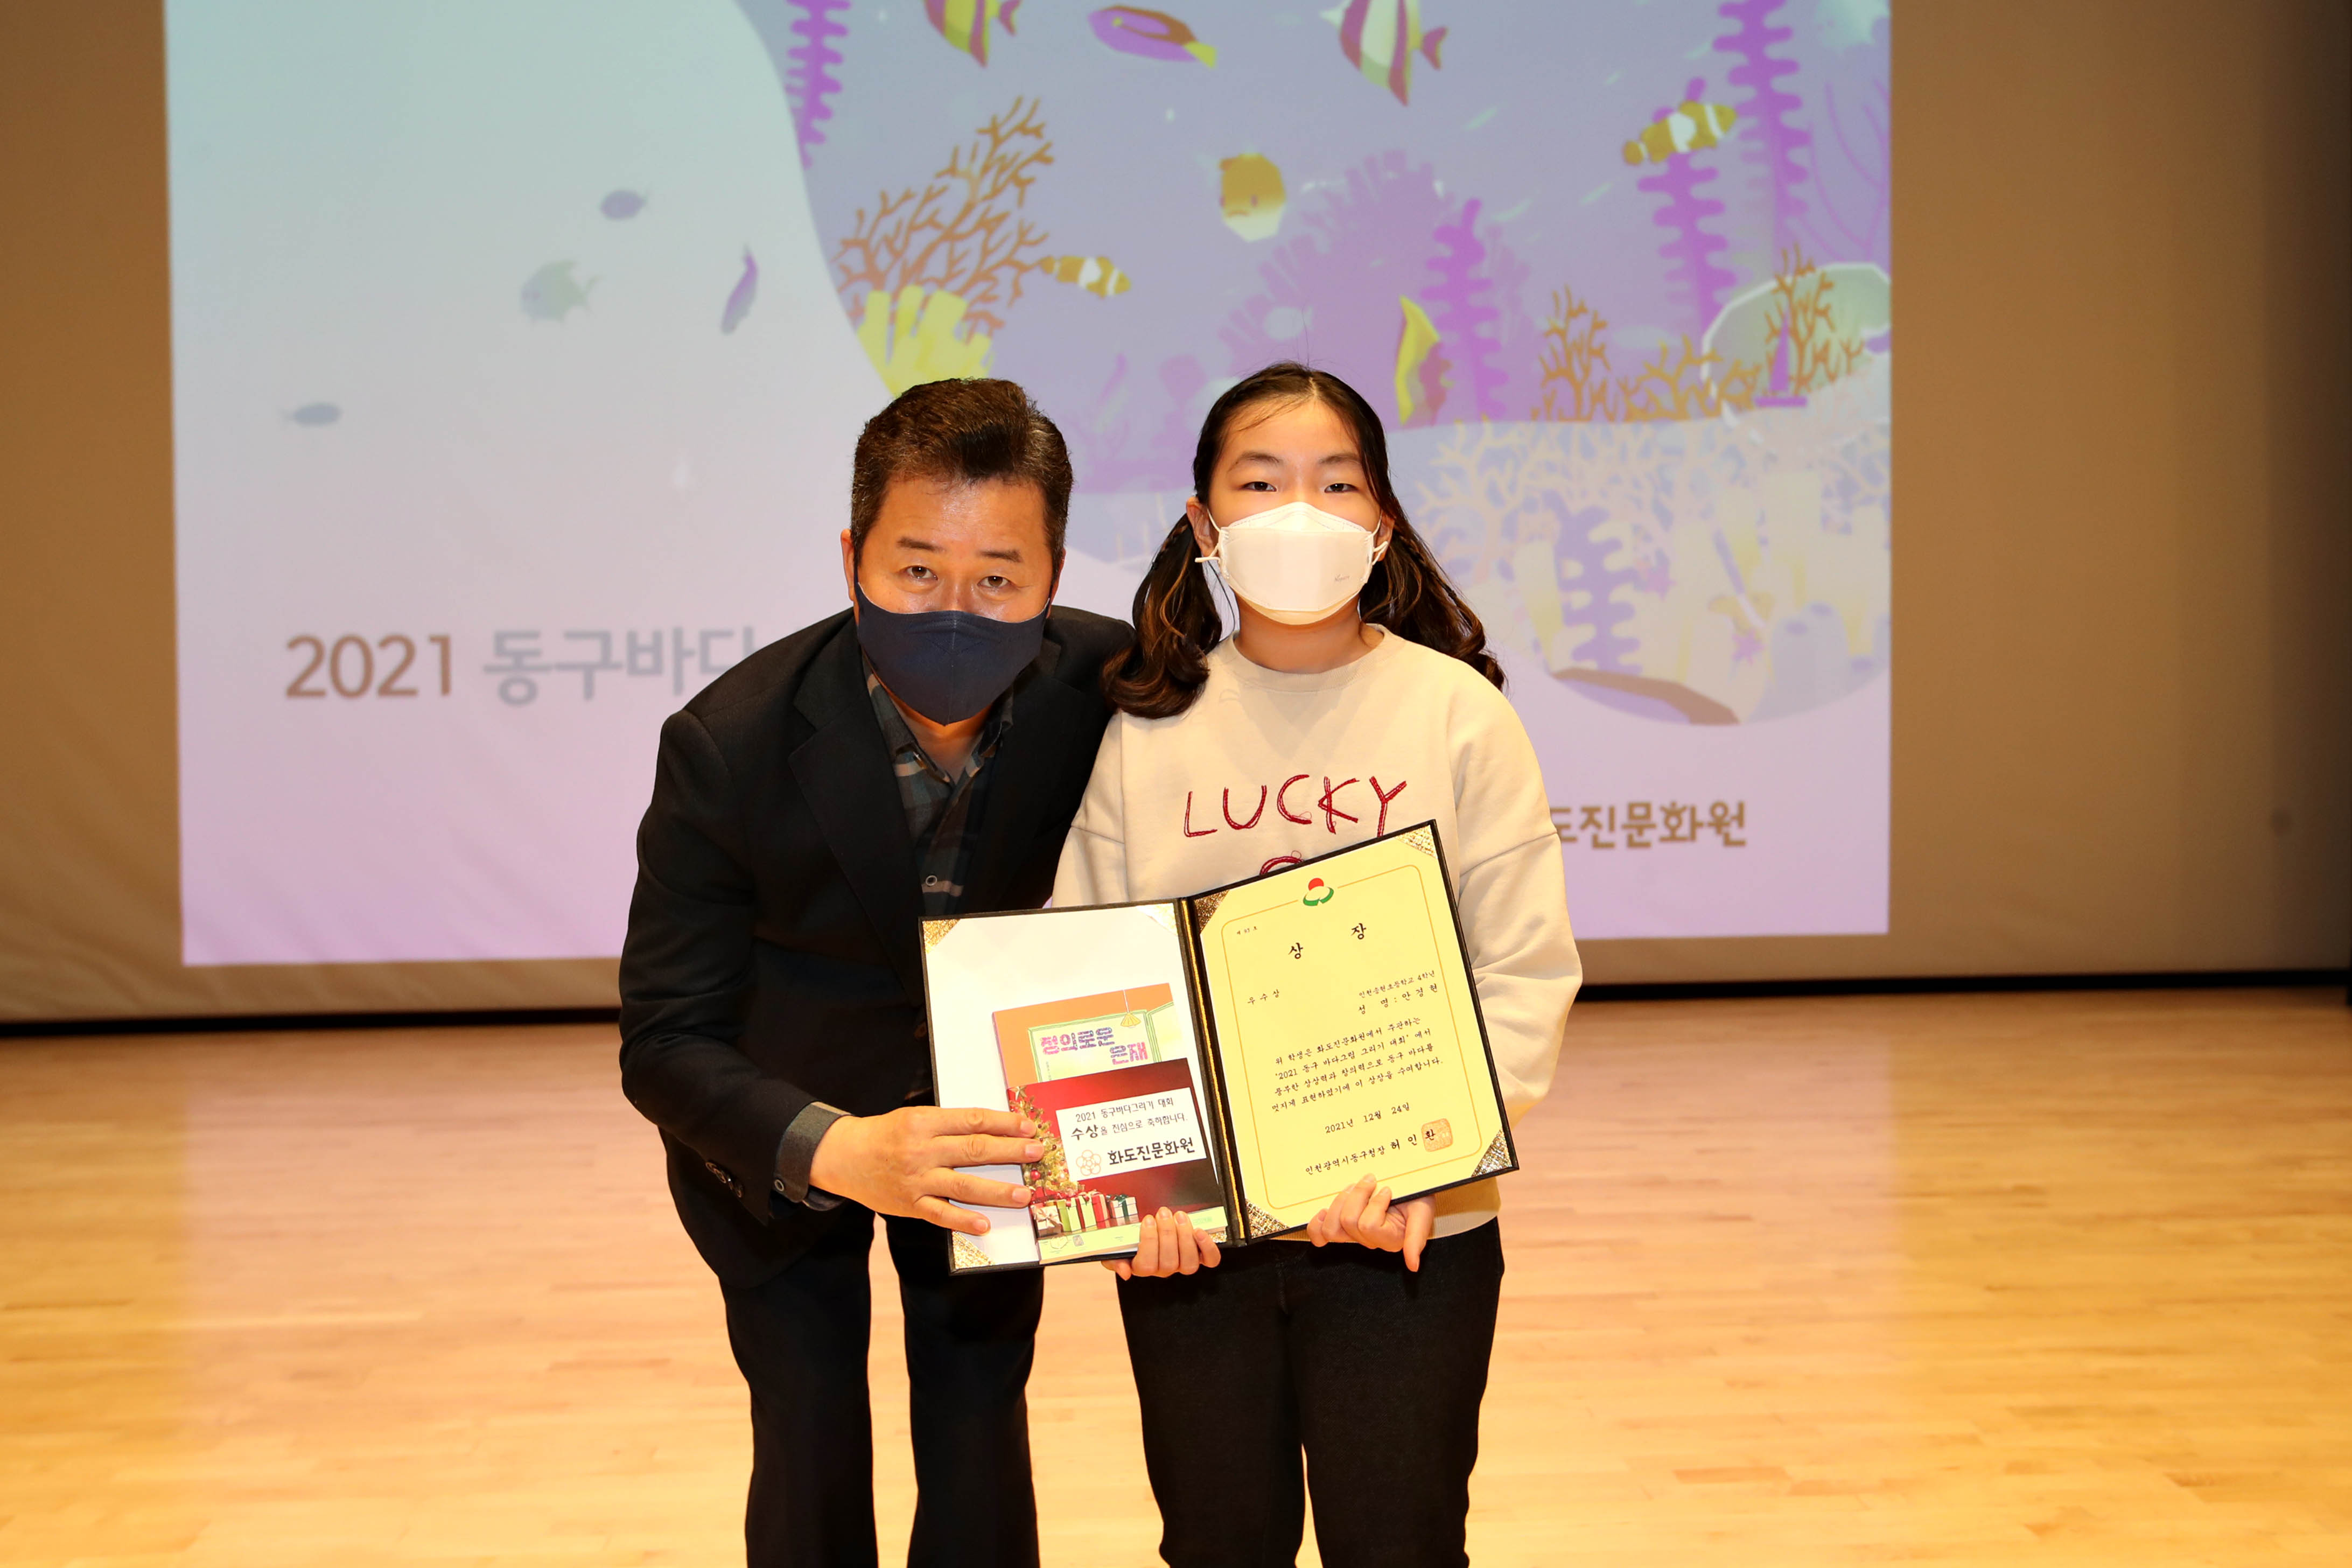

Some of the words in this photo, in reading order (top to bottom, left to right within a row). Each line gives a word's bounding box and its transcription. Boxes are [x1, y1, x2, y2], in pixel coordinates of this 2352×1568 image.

[285, 634, 452, 698] 2021
[1184, 774, 1408, 838] LUCKY
[1287, 942, 1304, 960] 상
[1350, 922, 1367, 940] 장
[1275, 1056, 1283, 1065] 위
[1287, 1048, 1312, 1061] 학생은
[1316, 1027, 1382, 1053] 화도진문화원에서
[1387, 1017, 1420, 1032] 주관하는
[1302, 1061, 1319, 1073] 동구
[1323, 1051, 1355, 1066] 바다그림
[1361, 1041, 1385, 1055] 그리기
[1414, 1027, 1431, 1038] 에서
[1271, 1098, 1296, 1112] 멋지게
[1301, 1082, 1350, 1104] 표현하였기에
[1355, 1079, 1363, 1088] 이
[1368, 1070, 1393, 1084] 상장을
[1397, 1056, 1444, 1075] 수여합니다.
[1275, 1082, 1299, 1096] 풍부한
[1304, 1071, 1337, 1088] 상상력과
[1341, 1058, 1383, 1077] 창의력으로
[1387, 1052, 1404, 1063] 동구
[1408, 1042, 1434, 1056] 바다를
[1075, 1111, 1096, 1123] 2021
[1101, 1100, 1154, 1118] 동구바다그리기
[1157, 1097, 1174, 1108] 대회
[1111, 1119, 1143, 1134] 진심으로
[1147, 1112, 1188, 1127] 축하합니다.
[1325, 1118, 1354, 1134] 2021년
[1363, 1110, 1382, 1123] 12월
[1391, 1102, 1410, 1115] 24일
[1107, 1137, 1195, 1166] 화도진문화원
[1305, 1145, 1385, 1175] 인천광역시동구청장
